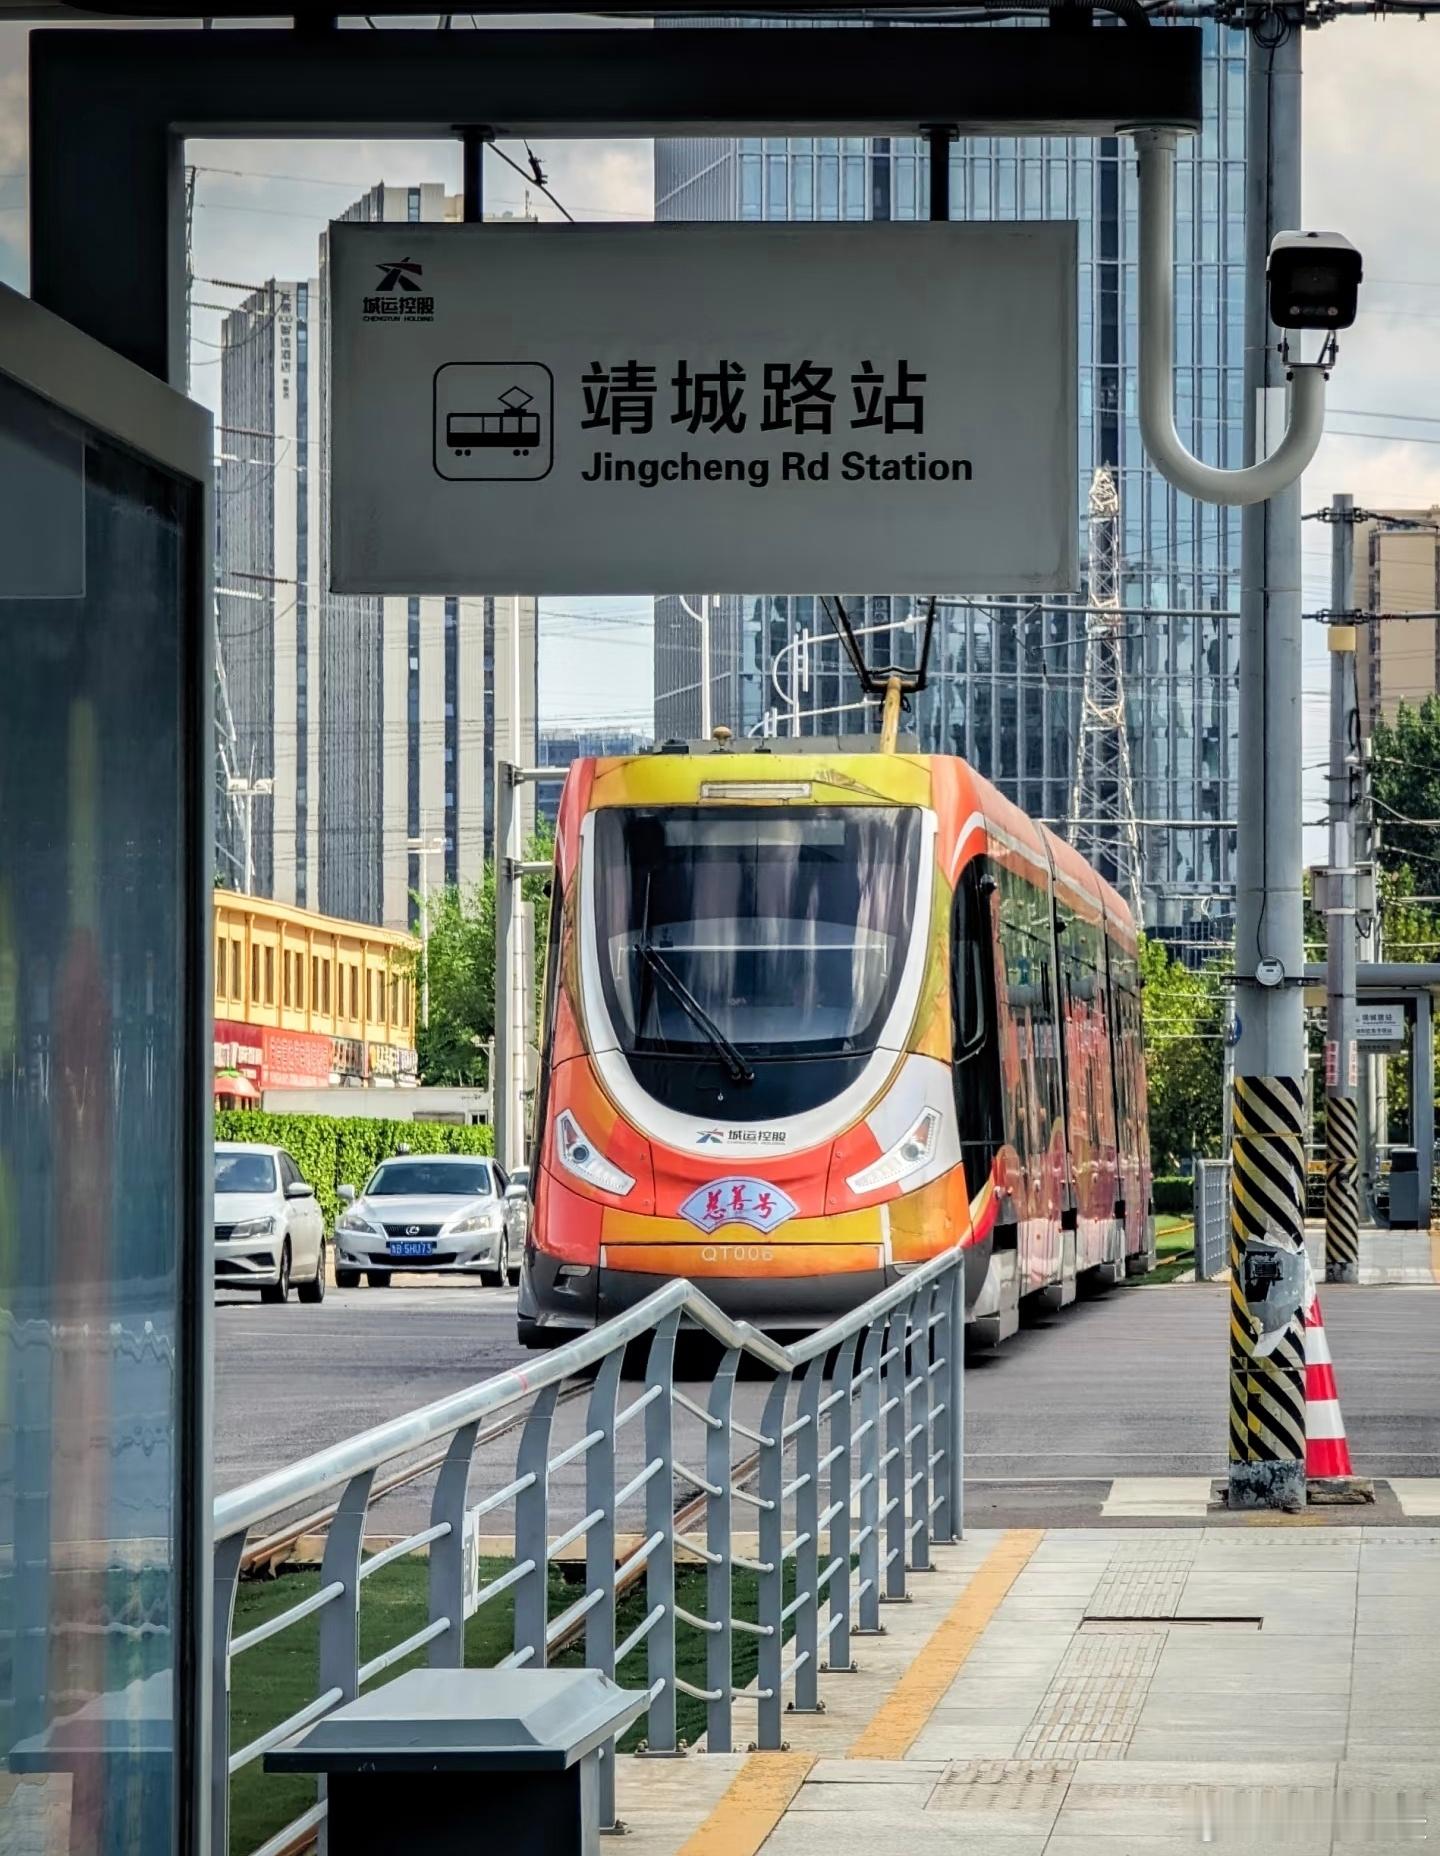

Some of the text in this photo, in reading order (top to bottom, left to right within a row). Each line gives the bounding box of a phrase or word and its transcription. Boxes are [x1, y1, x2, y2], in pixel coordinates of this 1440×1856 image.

[362, 297, 435, 314] 城运控股
[581, 360, 926, 434] 靖城路站
[582, 451, 971, 487] Jingcheng Rd Station
[727, 1130, 786, 1142] 城运控股
[702, 1184, 777, 1221] 慈善号
